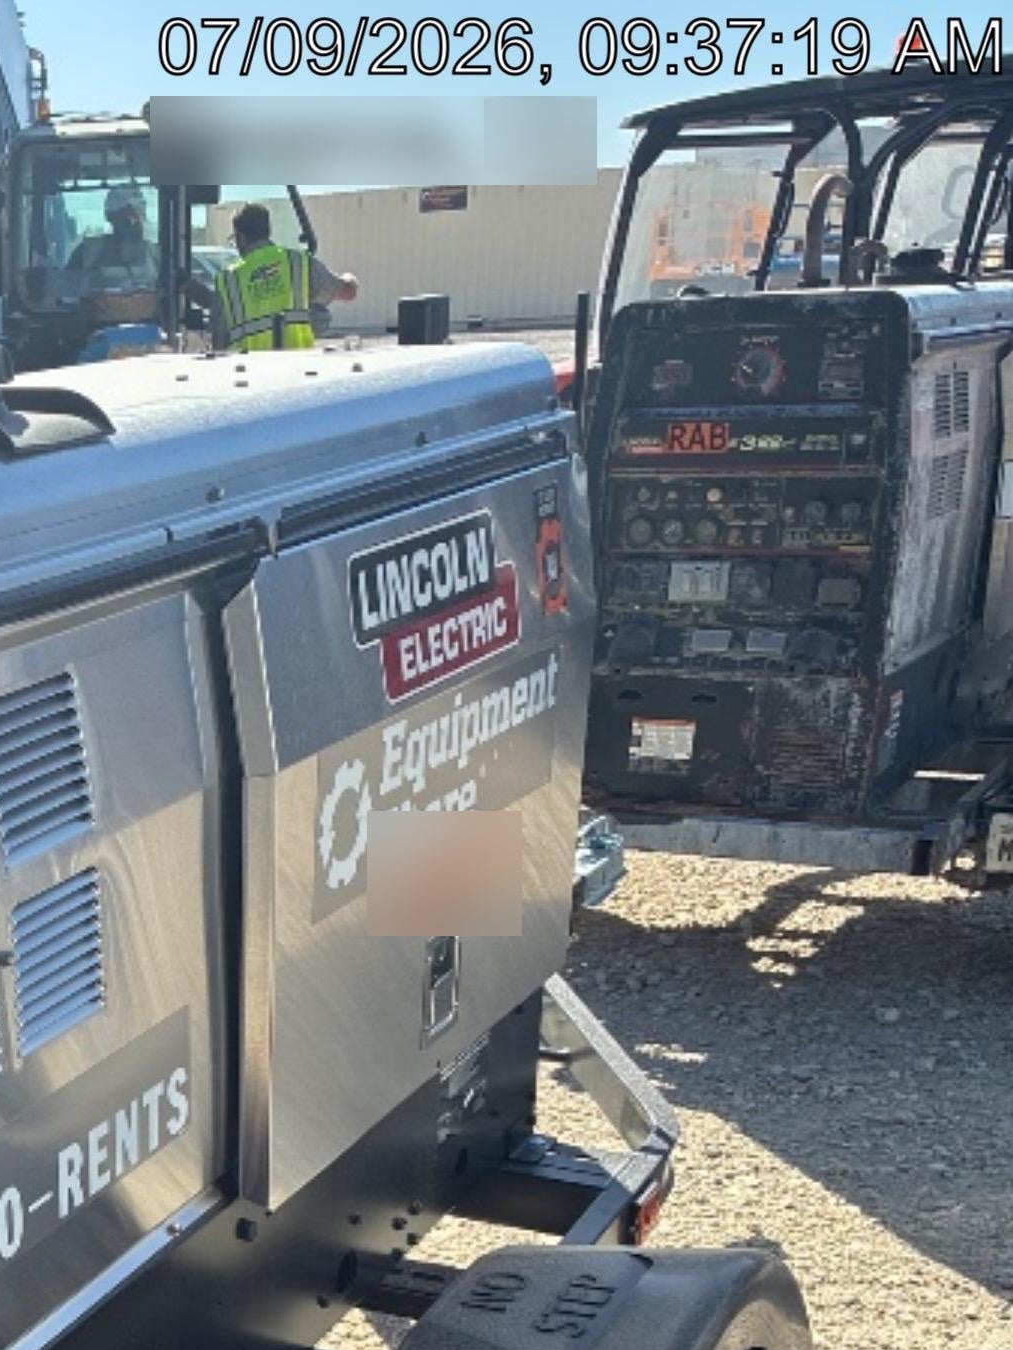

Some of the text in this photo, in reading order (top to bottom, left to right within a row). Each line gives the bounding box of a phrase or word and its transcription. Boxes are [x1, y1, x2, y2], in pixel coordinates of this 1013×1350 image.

[669, 423, 728, 451] RAB
[357, 525, 489, 632] LINCOLN
[396, 596, 508, 682] ELECTRIC
[378, 651, 560, 797] Equipment
